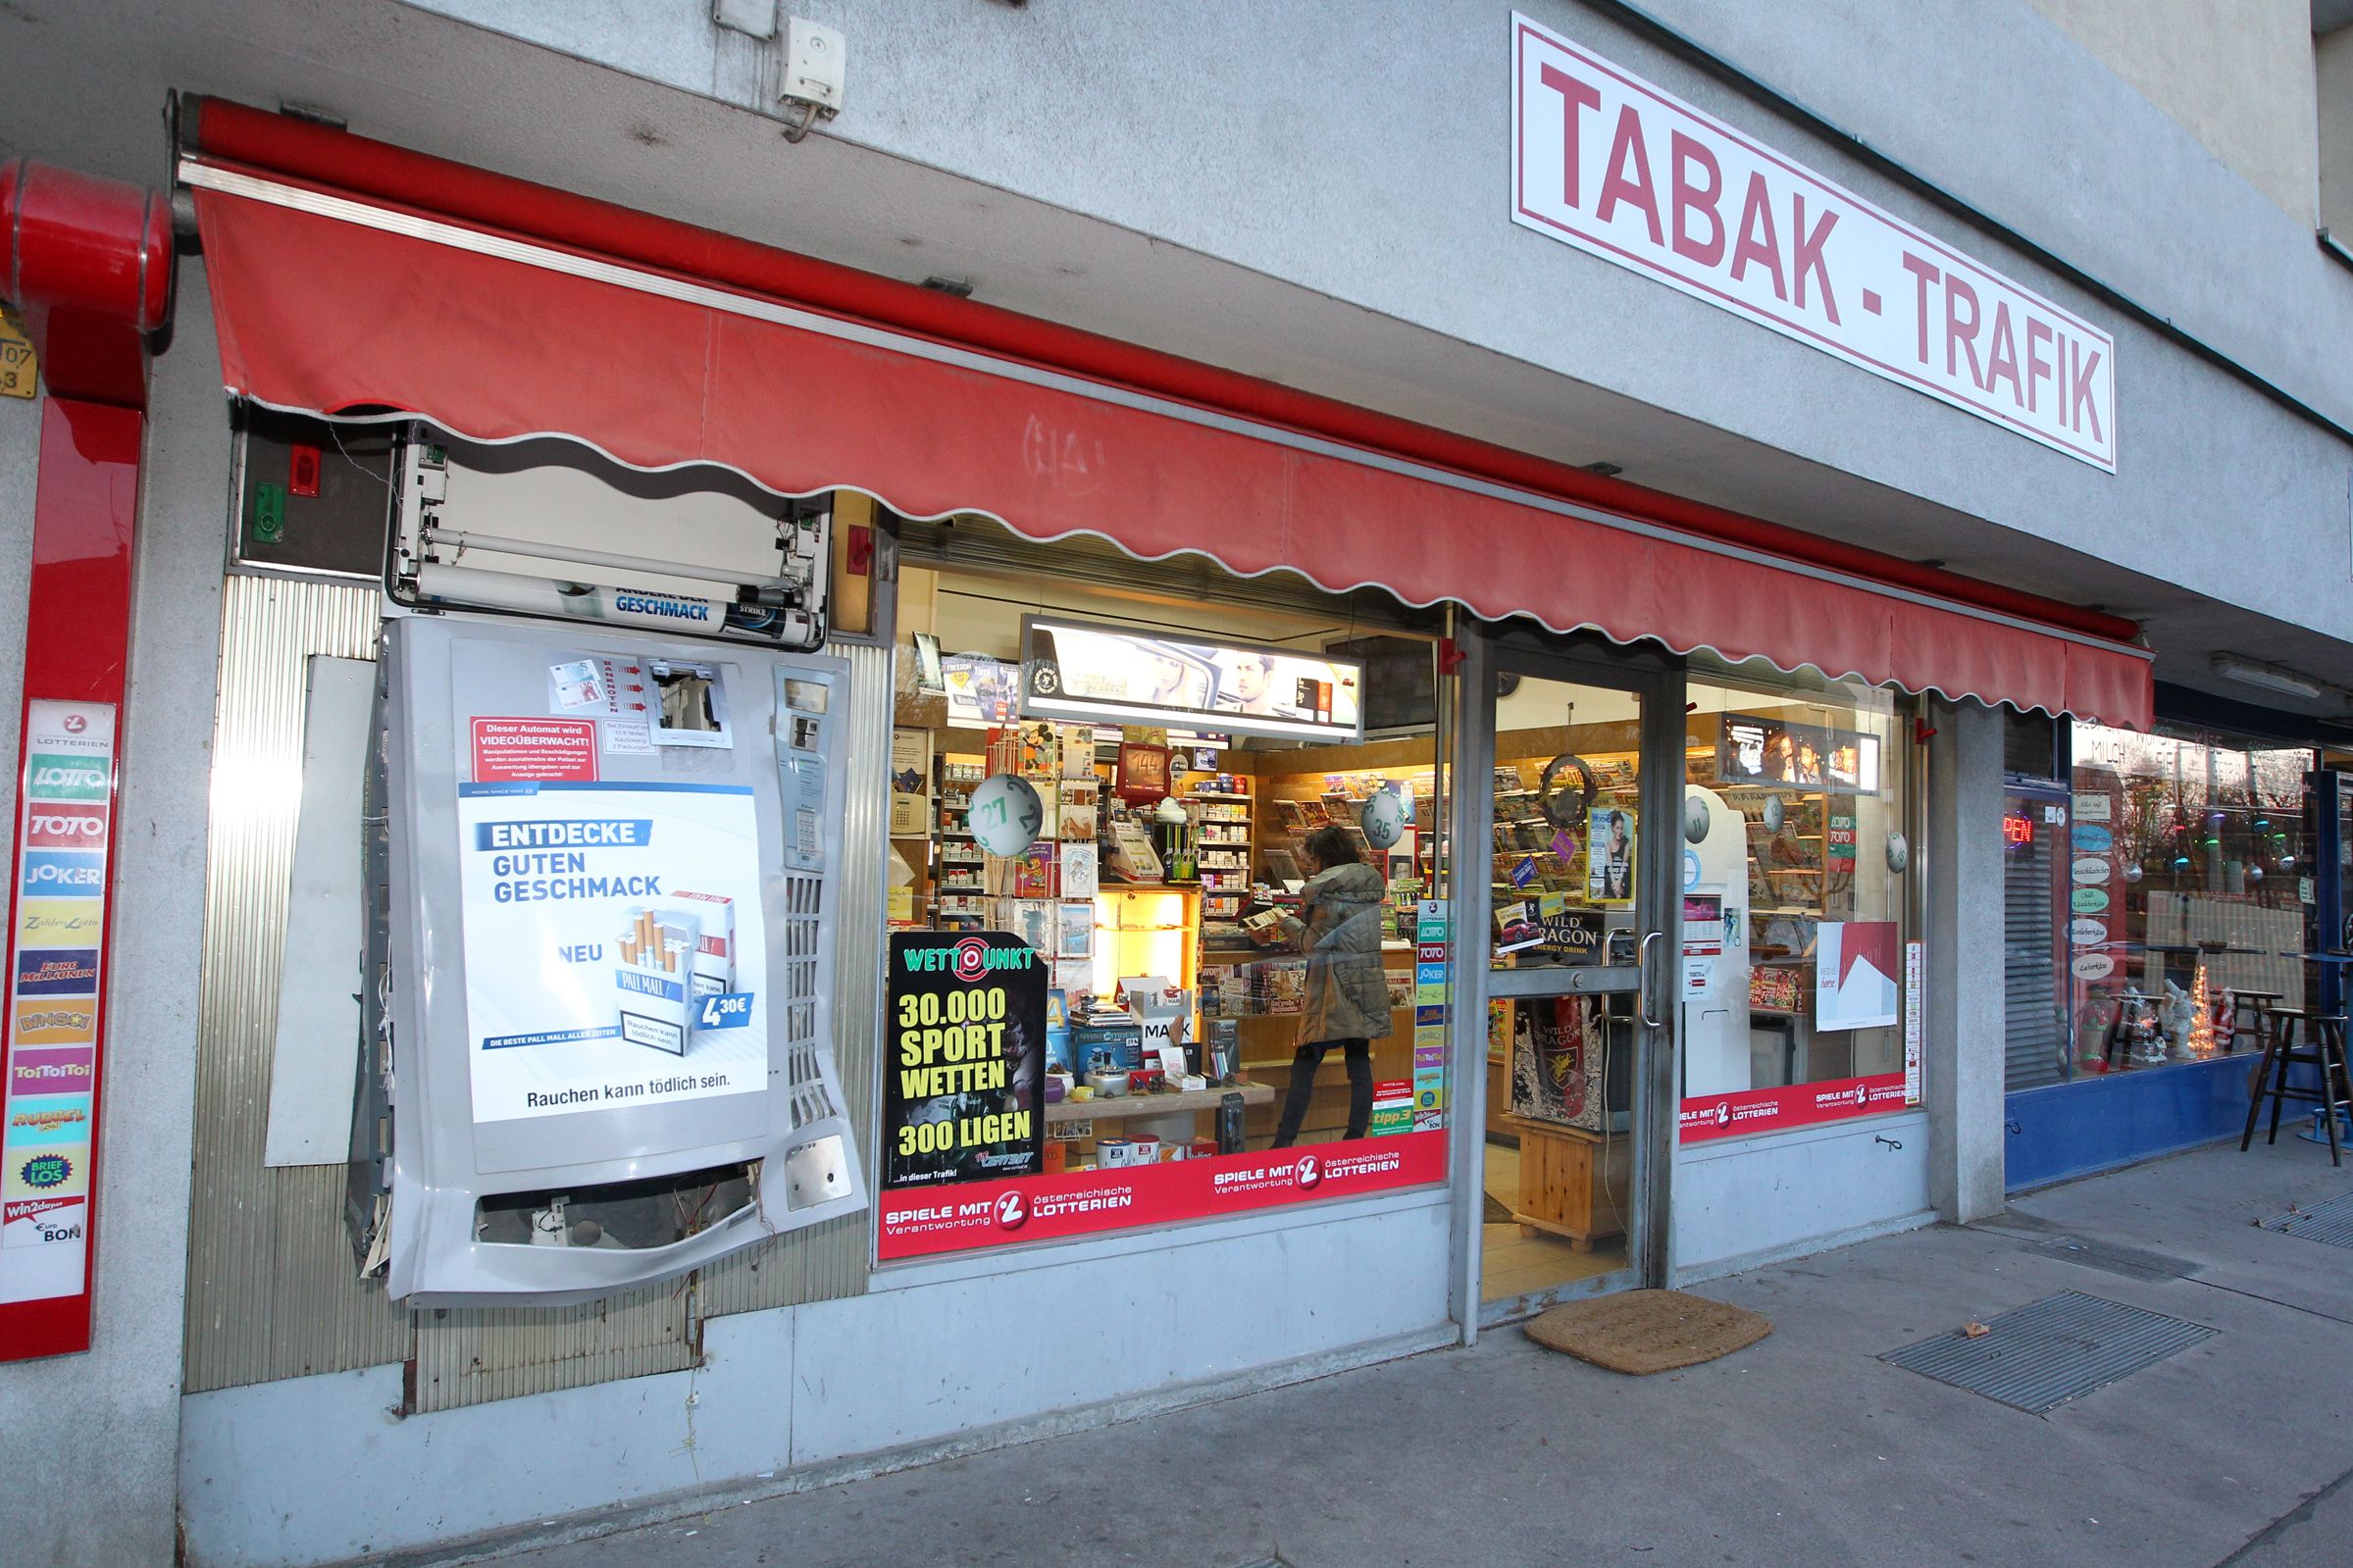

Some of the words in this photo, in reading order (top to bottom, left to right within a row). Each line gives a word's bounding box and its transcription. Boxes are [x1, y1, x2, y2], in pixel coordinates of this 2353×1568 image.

[1541, 61, 1842, 328] TABAK
[1863, 287, 1882, 317] -
[1902, 250, 2104, 444] TRAFIK
[616, 595, 708, 621] GESCHMACK
[740, 605, 766, 617] STRIKE
[974, 666, 991, 677] Tirol
[603, 660, 618, 713] BANKNOTEN
[486, 725, 517, 733] Dieser
[520, 725, 560, 734] Automat
[562, 726, 582, 734] wird
[37, 738, 108, 748] LOTTERIEN
[480, 735, 588, 746] VIDEOÜBERWACHT!
[2092, 740, 2125, 765] MILCH
[34, 767, 105, 785] LOTTO
[983, 795, 1007, 829] 27
[31, 815, 103, 835] TOTO
[1373, 819, 1391, 840] 35
[2004, 817, 2031, 841] PEN
[491, 822, 636, 848] ENTDECKE
[1830, 832, 1850, 842] TOTO
[492, 852, 586, 876] GUTEN
[26, 864, 101, 885] JOKER
[493, 876, 661, 903] GESCHMACK
[1541, 916, 1581, 929] WILD
[1421, 927, 1444, 937] LOTTO
[1538, 928, 1599, 947] RAGON
[557, 943, 602, 963] NEU
[1420, 947, 1444, 959] TOTO
[41, 961, 78, 973] EURO
[1419, 968, 1444, 980] JOKER
[622, 972, 641, 992] PALL
[641, 976, 664, 996] MALL
[898, 987, 1005, 1028] 30.000
[20, 1012, 90, 1032] BINGO!
[627, 1020, 658, 1034] Rauchen
[660, 1029, 678, 1039] kann
[1145, 1022, 1190, 1039] MAK
[1543, 1024, 1572, 1036] WILD
[503, 1037, 527, 1046] BESTE
[546, 1034, 566, 1042] MALL
[568, 1031, 589, 1040] ALLER
[590, 1029, 616, 1037] ZEITEN
[631, 1030, 656, 1041] tödlich
[899, 1024, 1005, 1067] SPORT
[15, 1064, 90, 1079] ToiToiToi
[900, 1060, 1005, 1099] WETTEN
[528, 1087, 598, 1108] Rauchen
[604, 1084, 644, 1099] kann
[649, 1075, 696, 1095] tödlich
[700, 1073, 731, 1088] sein.
[1816, 1091, 1840, 1101] SPIELE
[1842, 1089, 1855, 1099] MIT
[1868, 1088, 1906, 1101] LOTTERIEN
[1732, 1100, 1778, 1111] österreichische
[1816, 1099, 1855, 1109] Verantwortung
[12, 1109, 85, 1127] RUBBEL
[1679, 1110, 1698, 1121] IELE
[1700, 1108, 1715, 1119] MIT
[1732, 1107, 1778, 1121] LOTTERIEN
[1679, 1118, 1714, 1129] antwortung
[898, 1120, 953, 1156] 300
[960, 1111, 1031, 1146] LIGEN
[31, 1160, 63, 1171] BRIEF
[1325, 1151, 1400, 1167] österreichische
[30, 1170, 64, 1183] LOS
[908, 1172, 932, 1182] dieser
[934, 1169, 956, 1179] Trafik!
[1214, 1168, 1265, 1185] SPIELE
[1269, 1164, 1295, 1177] MIT
[1325, 1160, 1400, 1179] LOTTERIEN
[1034, 1185, 1132, 1205] österreichische
[1214, 1178, 1294, 1195] Verantwortung
[886, 1206, 952, 1225] SPIELE
[959, 1201, 993, 1216] MIT
[1033, 1195, 1132, 1218] LOTTERIEN
[44, 1227, 80, 1241] BON
[886, 1216, 991, 1236] Verantwortung
